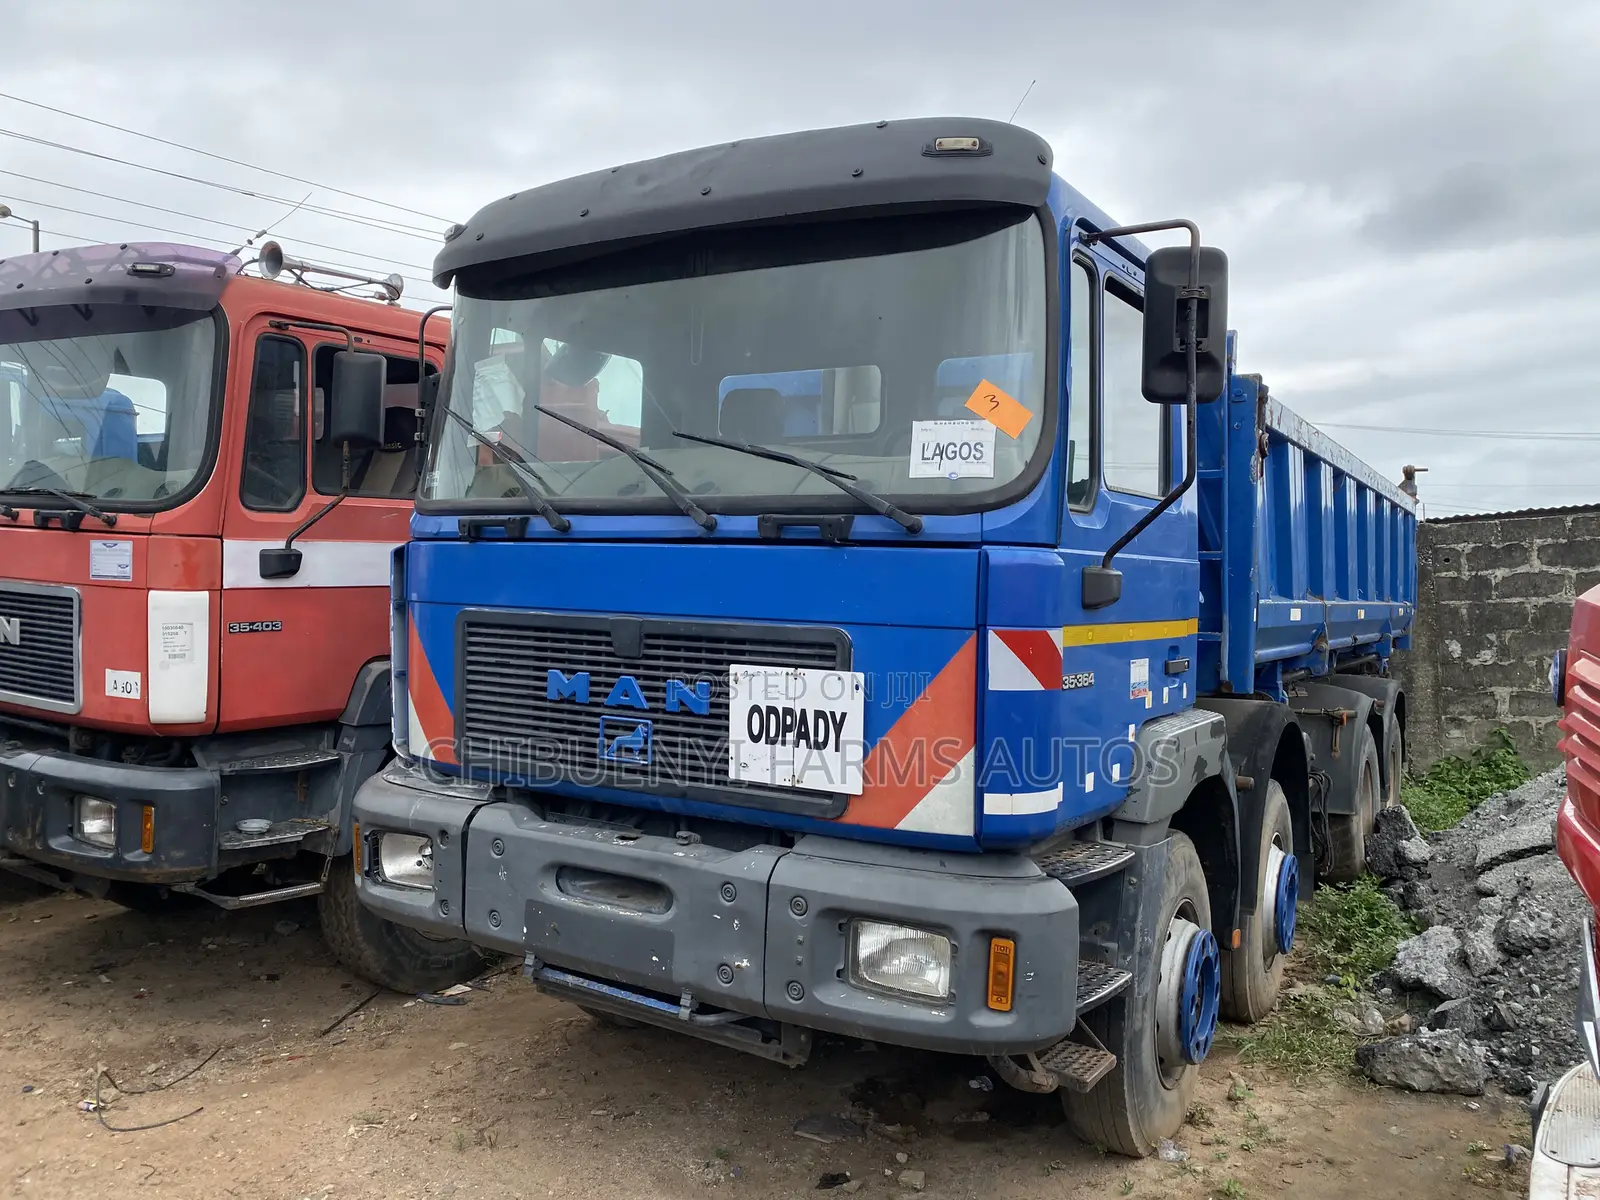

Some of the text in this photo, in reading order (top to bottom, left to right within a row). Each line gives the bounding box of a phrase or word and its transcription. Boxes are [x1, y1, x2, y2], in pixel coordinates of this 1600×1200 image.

[983, 394, 1000, 413] 3
[921, 441, 984, 461] LAGOS
[546, 669, 710, 715] MAN
[747, 704, 848, 753] ODPADY
